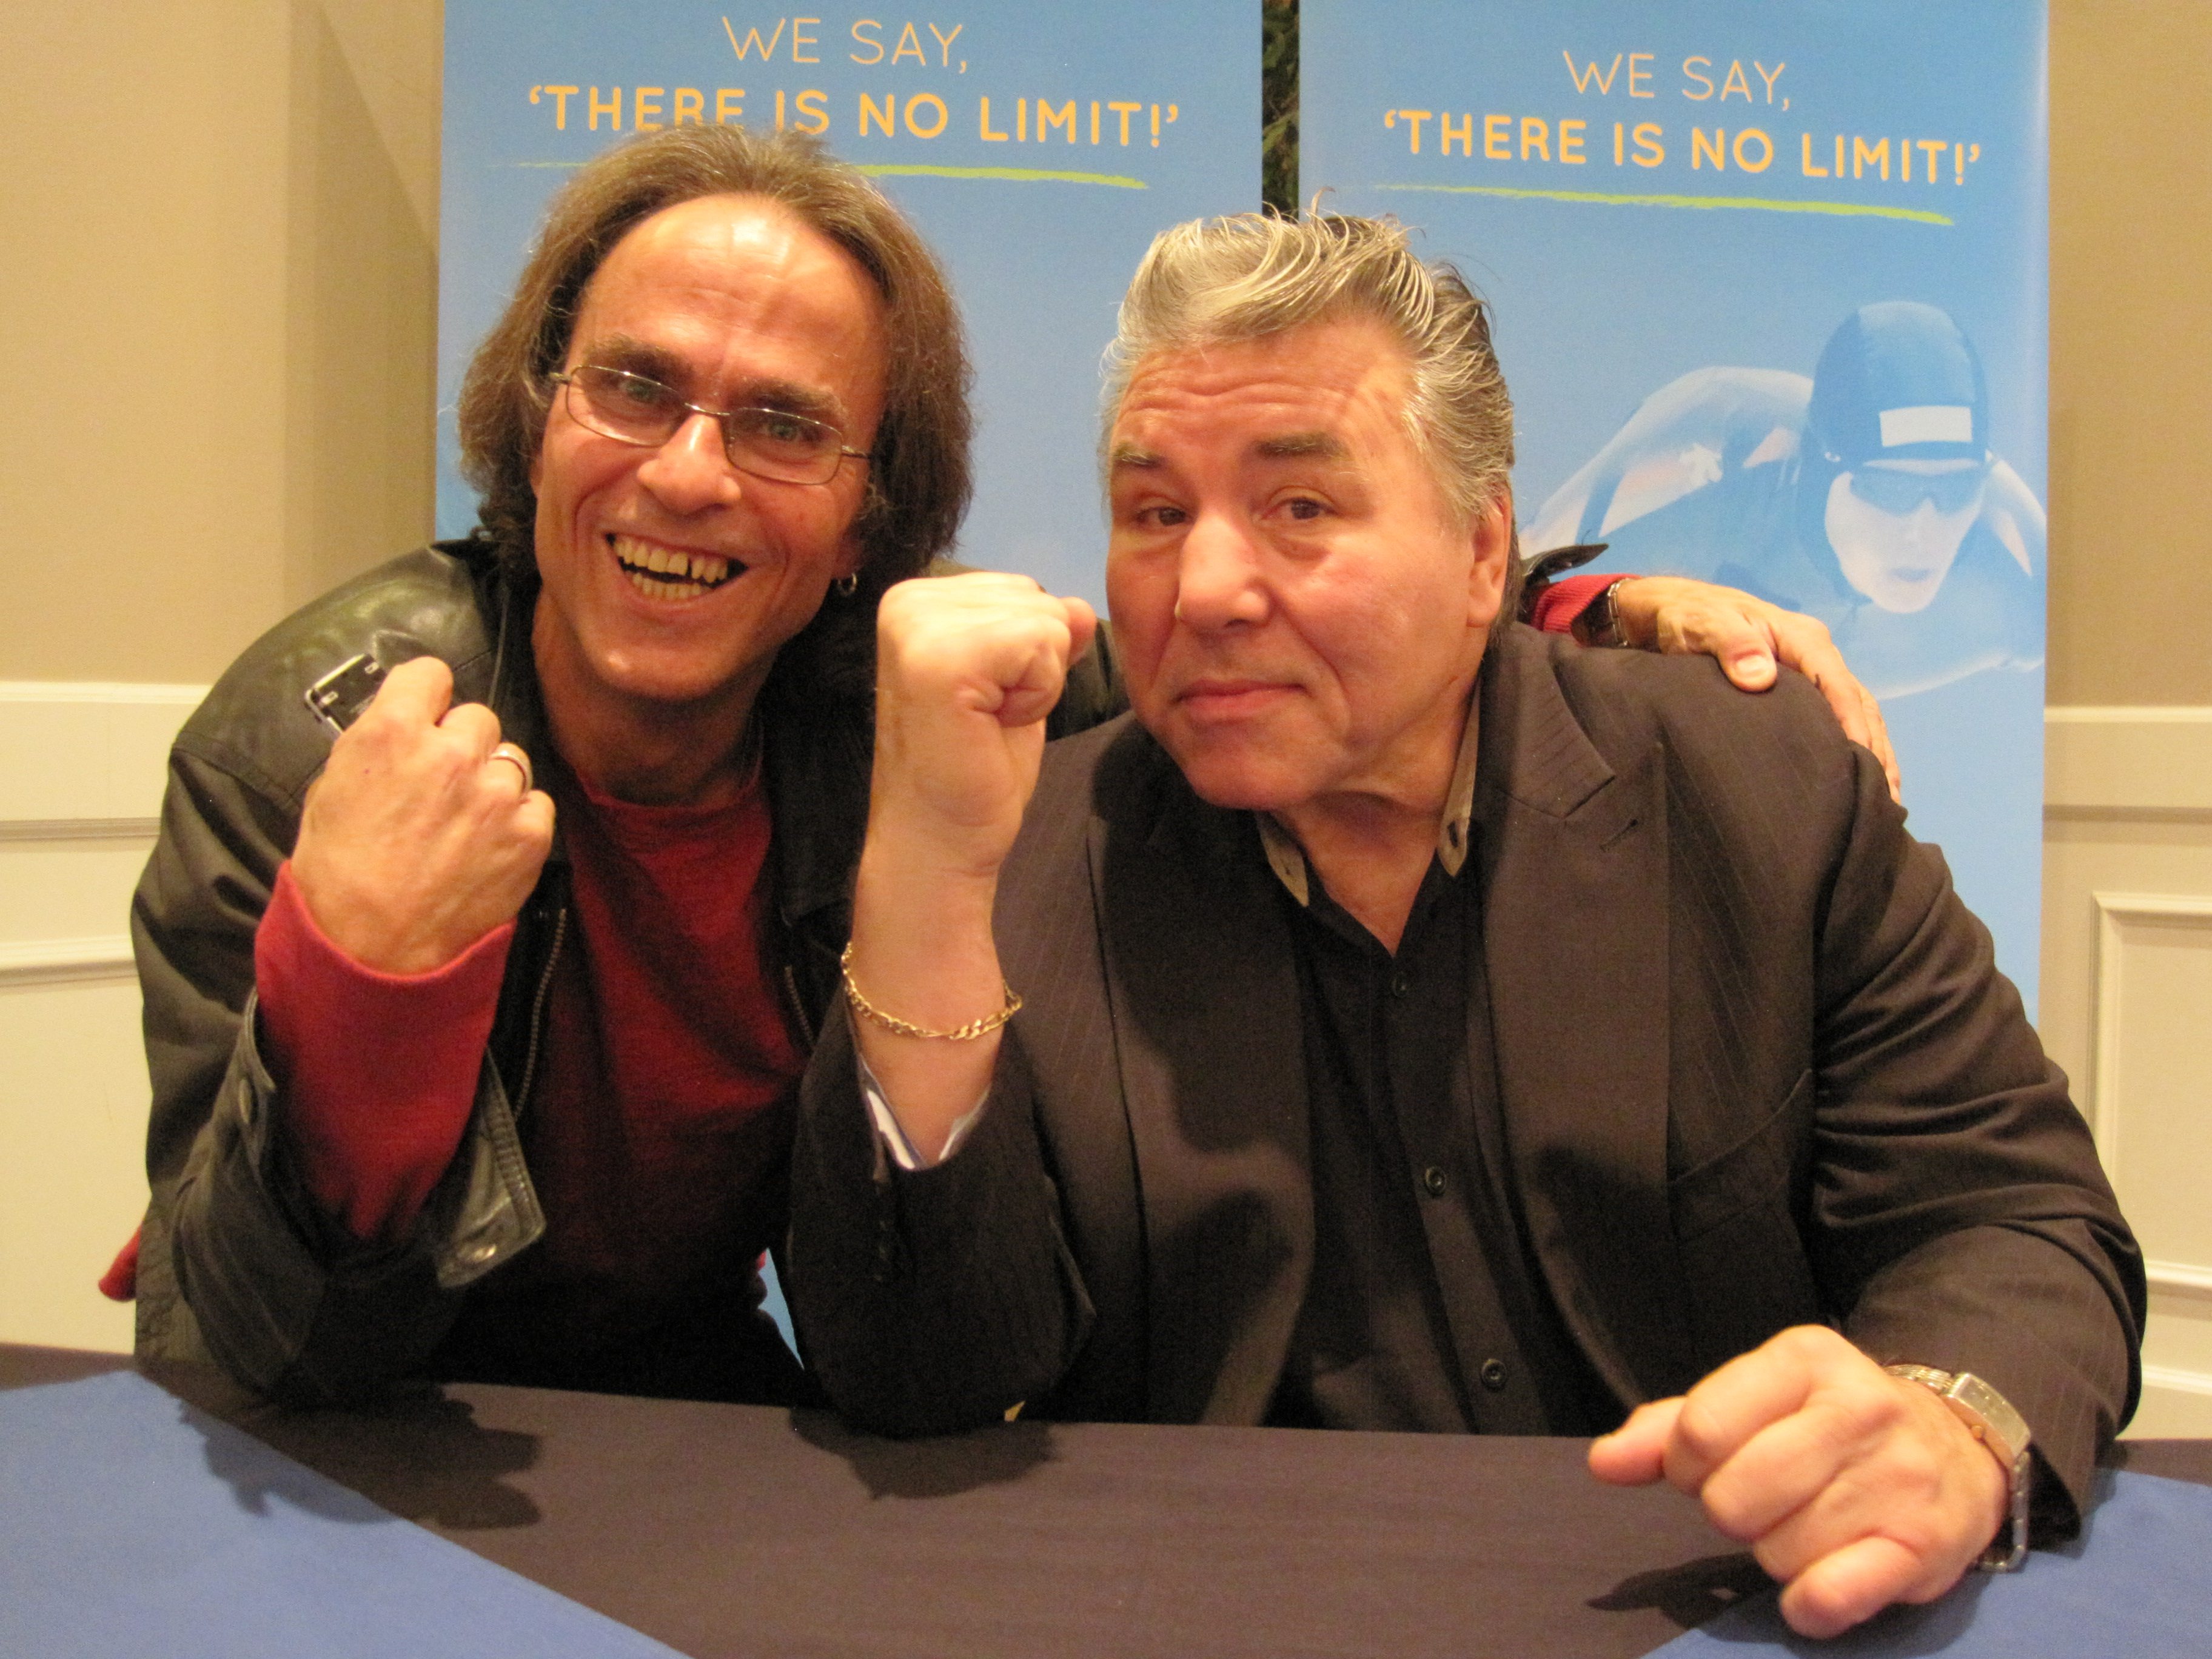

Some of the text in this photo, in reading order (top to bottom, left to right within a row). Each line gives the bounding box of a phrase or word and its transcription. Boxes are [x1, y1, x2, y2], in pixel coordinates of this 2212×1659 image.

[722, 16, 967, 73] WE SAY,
[1564, 51, 1789, 110] WE SAY,
[775, 88, 830, 135] IS
[859, 92, 950, 139] NO
[980, 96, 1179, 147] LIMIT!’
[1384, 109, 1980, 186] ‘THERE IS NO LIMIT!’
